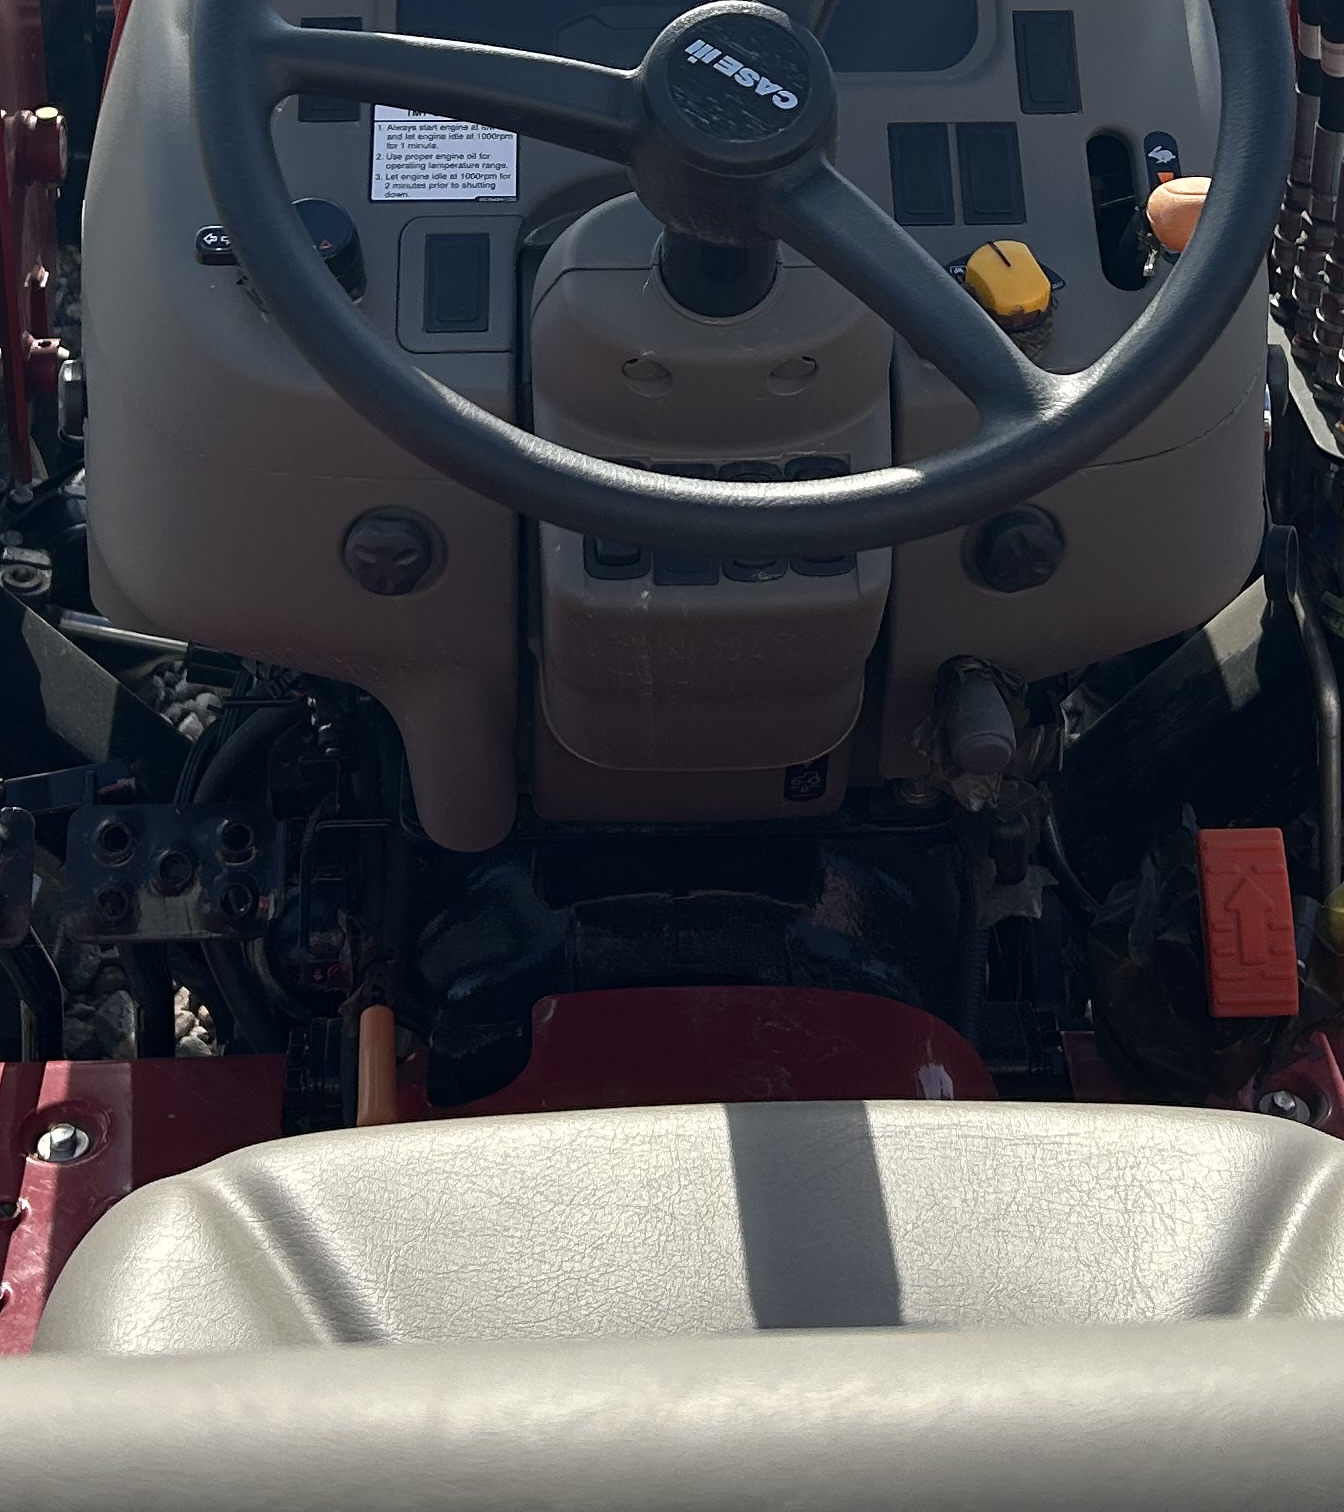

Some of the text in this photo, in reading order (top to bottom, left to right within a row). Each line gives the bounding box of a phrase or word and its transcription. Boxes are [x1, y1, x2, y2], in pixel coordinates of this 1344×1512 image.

[387, 124, 417, 133] Always
[440, 124, 469, 133] engine
[387, 132, 402, 140] and
[417, 133, 446, 142] engine
[448, 132, 464, 140] idle
[477, 132, 514, 142] 1000rpm
[405, 153, 433, 162] proper
[435, 153, 464, 162] engine
[466, 152, 477, 160] oil
[479, 152, 490, 160] for
[385, 162, 426, 170] operating
[428, 162, 479, 170] temperature
[400, 173, 429, 182] engine
[431, 172, 447, 180] idle
[428, 182, 448, 190] prior
[461, 182, 496, 190] shutting
